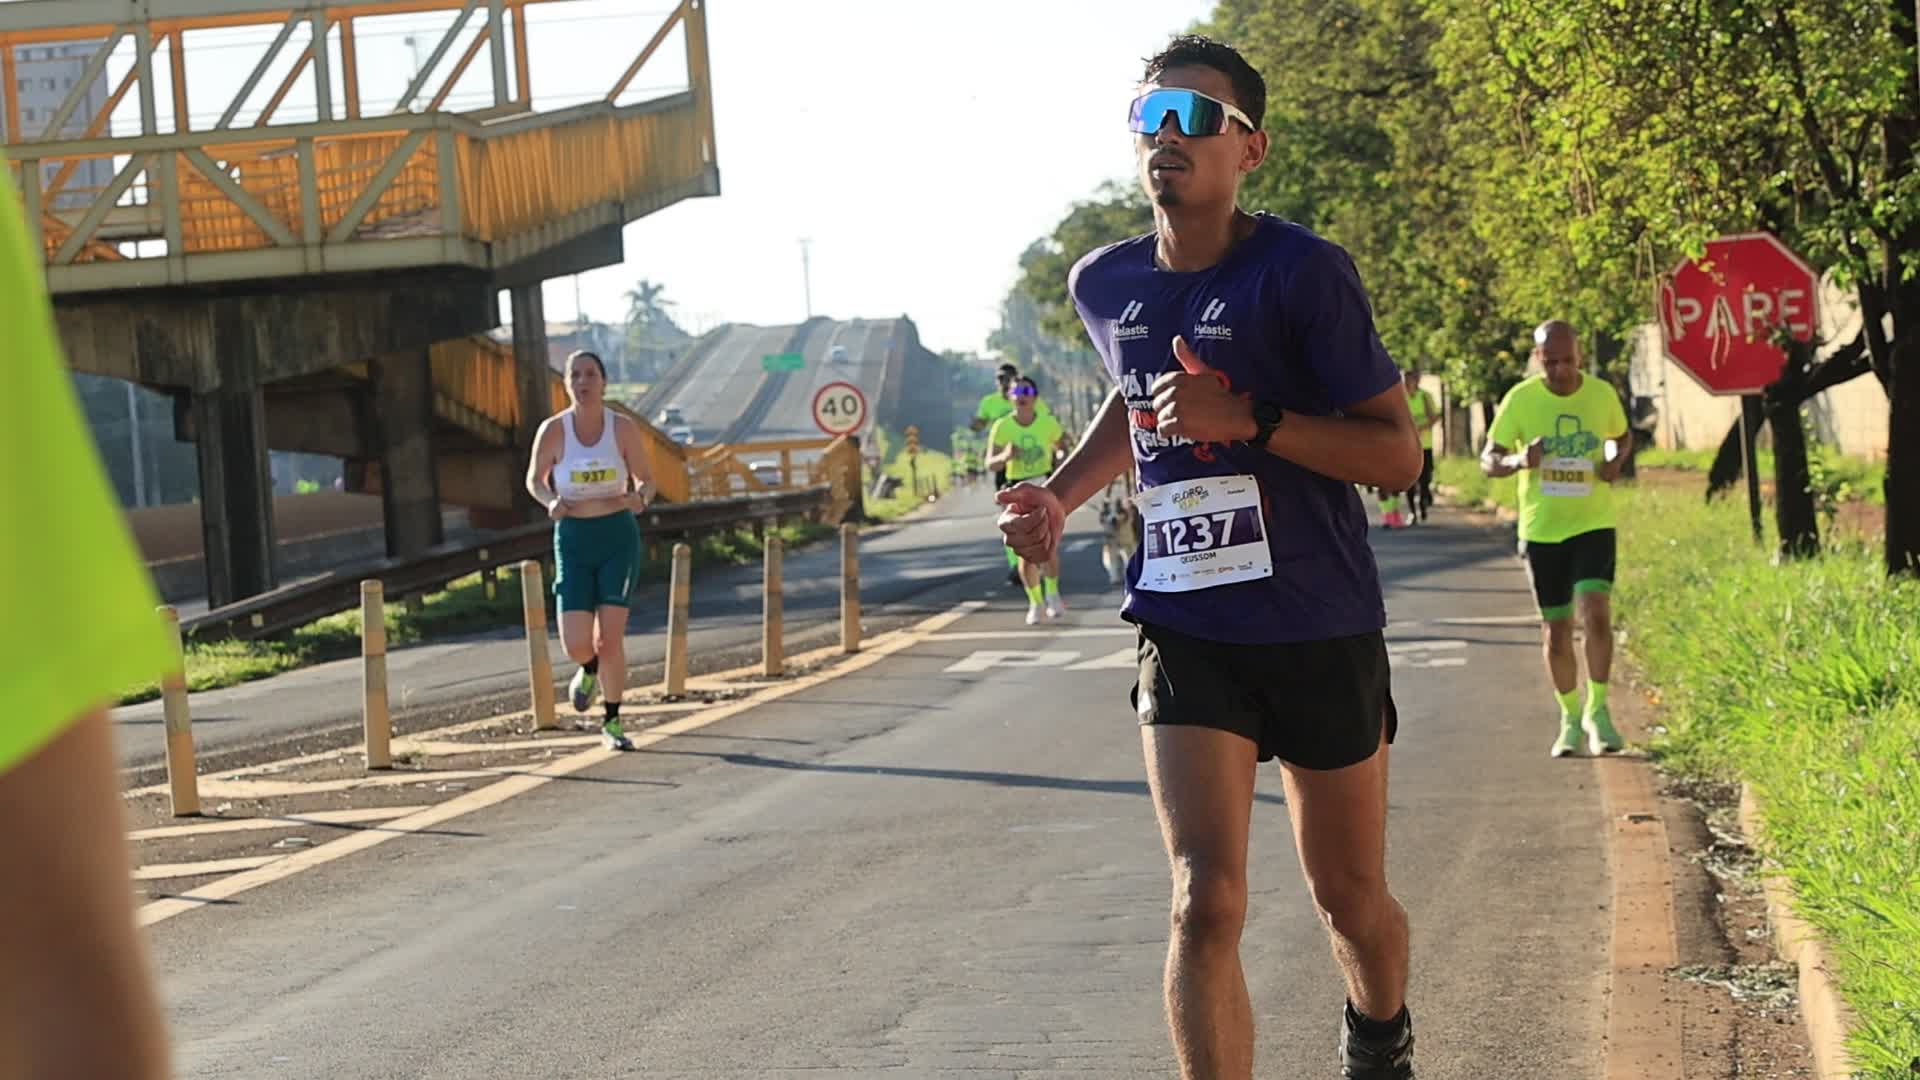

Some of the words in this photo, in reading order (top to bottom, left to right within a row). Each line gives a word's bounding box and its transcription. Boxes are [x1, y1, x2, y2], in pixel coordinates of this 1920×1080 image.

[1674, 290, 1808, 341] PARE
[822, 394, 858, 416] 40
[582, 469, 606, 482] 937
[1162, 511, 1236, 555] 1237
